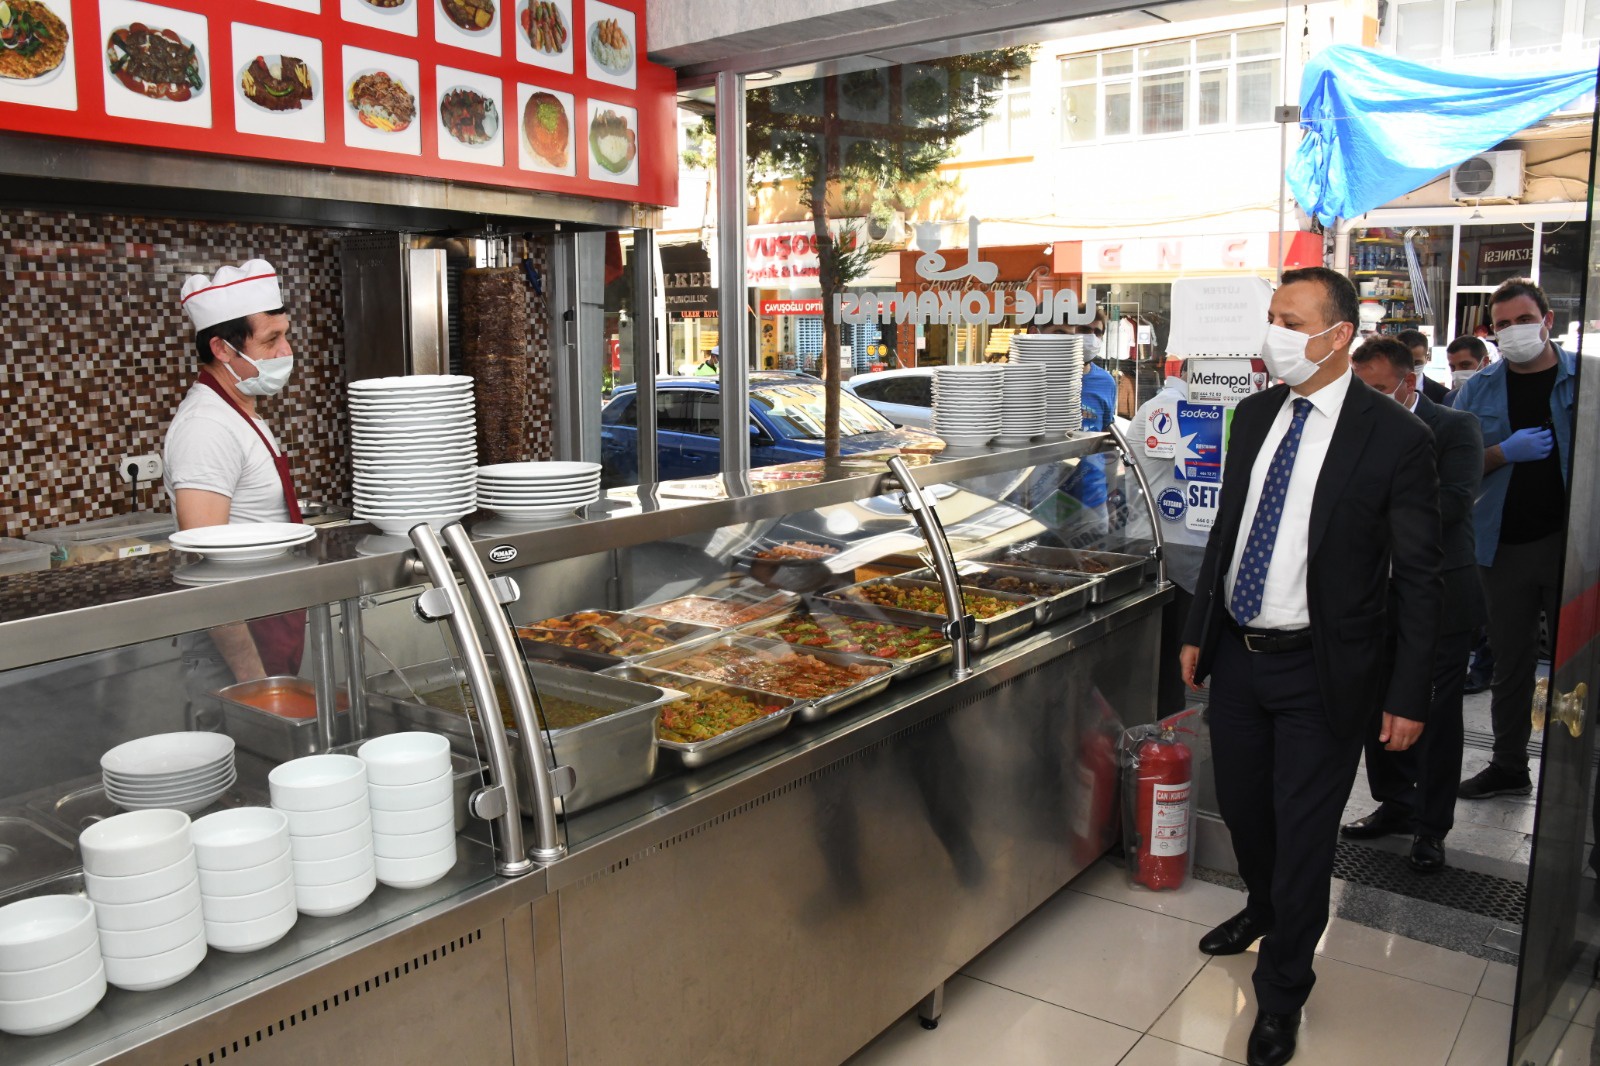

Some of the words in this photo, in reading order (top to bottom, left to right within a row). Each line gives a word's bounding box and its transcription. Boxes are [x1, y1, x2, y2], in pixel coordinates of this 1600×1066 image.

[806, 300, 823, 311] OPTİ
[1190, 372, 1250, 388] Metropol
[1231, 386, 1250, 394] Card
[1180, 408, 1219, 419] sodexo
[1188, 484, 1219, 508] SET
